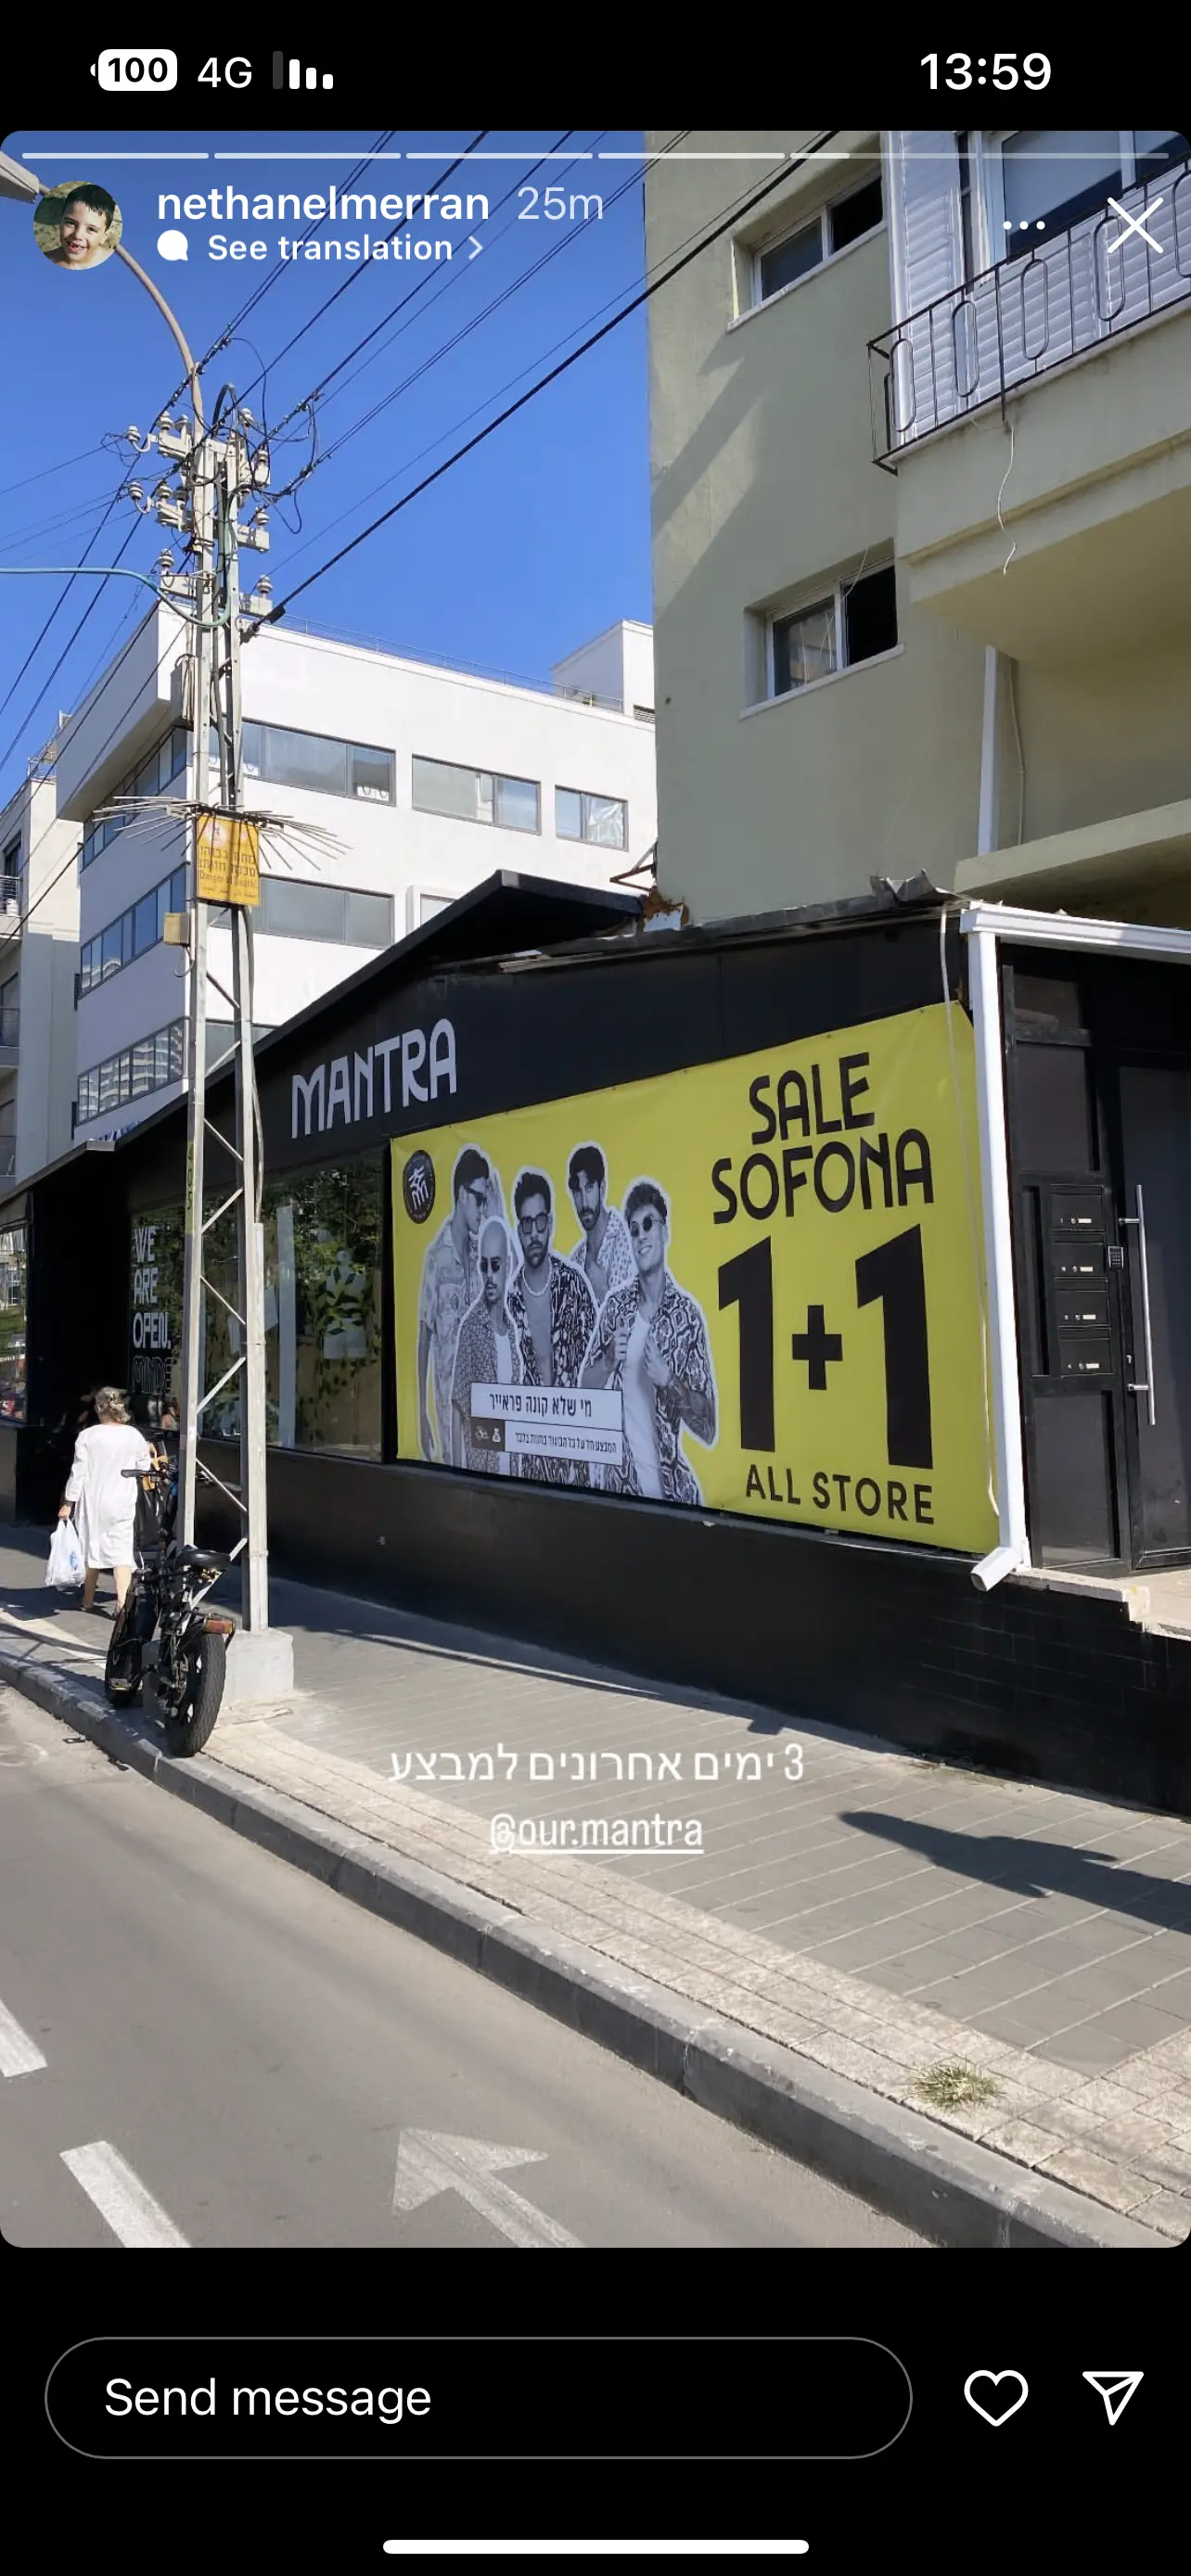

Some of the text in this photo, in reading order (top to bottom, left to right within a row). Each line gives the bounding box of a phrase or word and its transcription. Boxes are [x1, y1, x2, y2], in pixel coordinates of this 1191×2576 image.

[291, 1018, 458, 1140] MANTRA
[749, 1052, 876, 1145] SALE
[711, 1128, 935, 1225] SOFONA
[134, 1225, 157, 1263] WE
[134, 1267, 159, 1305] ARE
[717, 1223, 934, 1471] 1+1
[490, 1393, 593, 1418] מי שלא קונה פראייר
[745, 1463, 936, 1525] ALL STORE
